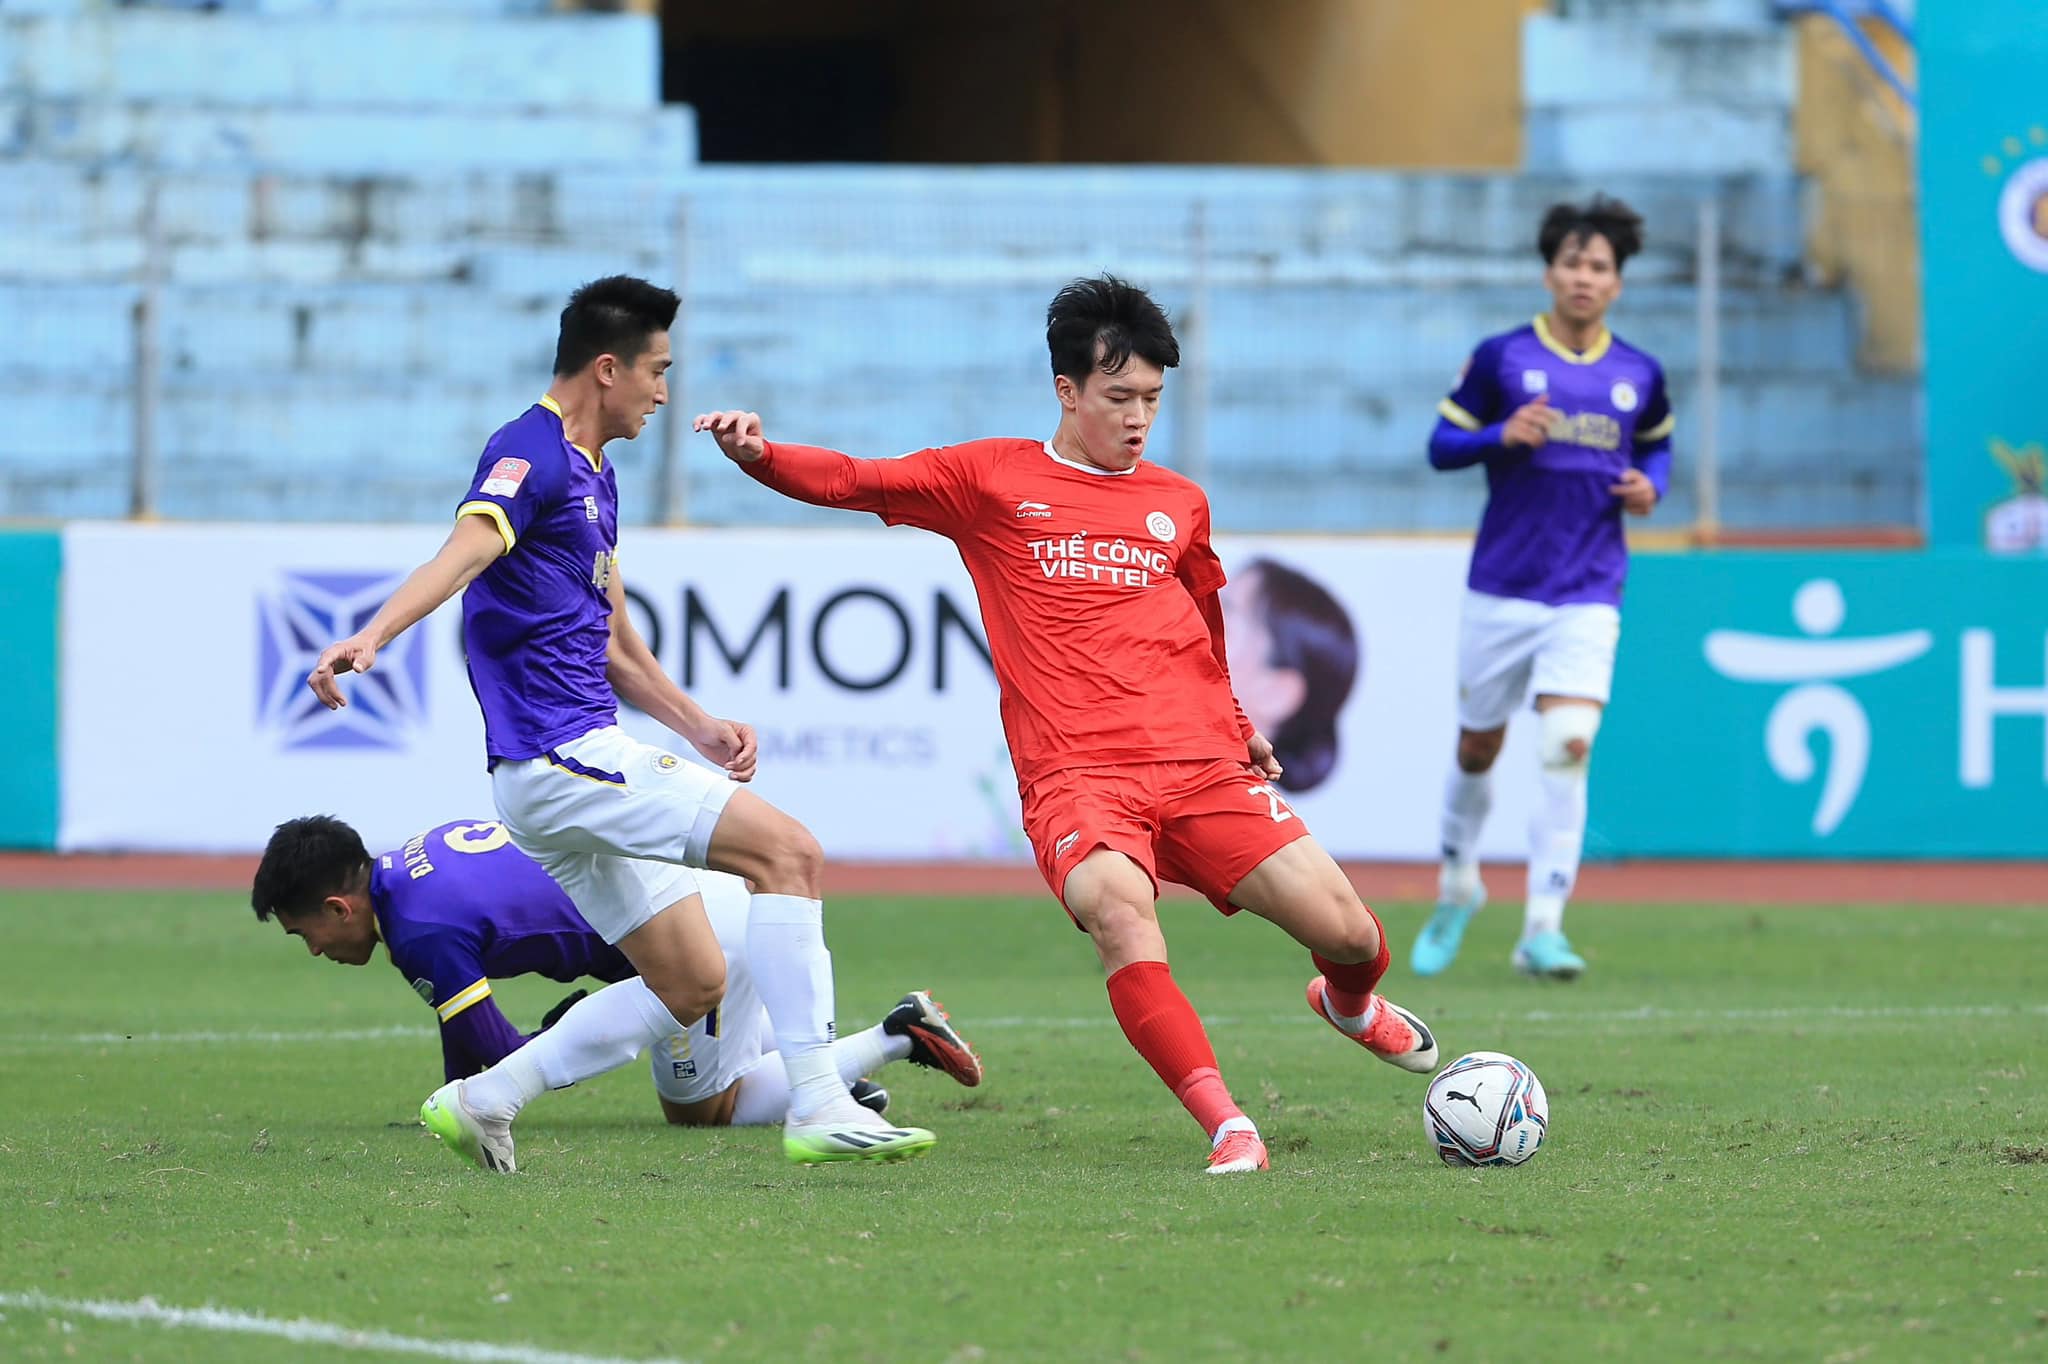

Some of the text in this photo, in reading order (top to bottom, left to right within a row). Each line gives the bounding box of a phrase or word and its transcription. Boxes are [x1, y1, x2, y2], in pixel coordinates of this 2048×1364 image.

[1027, 530, 1168, 573] THỂ CÔNG
[1040, 559, 1156, 588] VIETTEL
